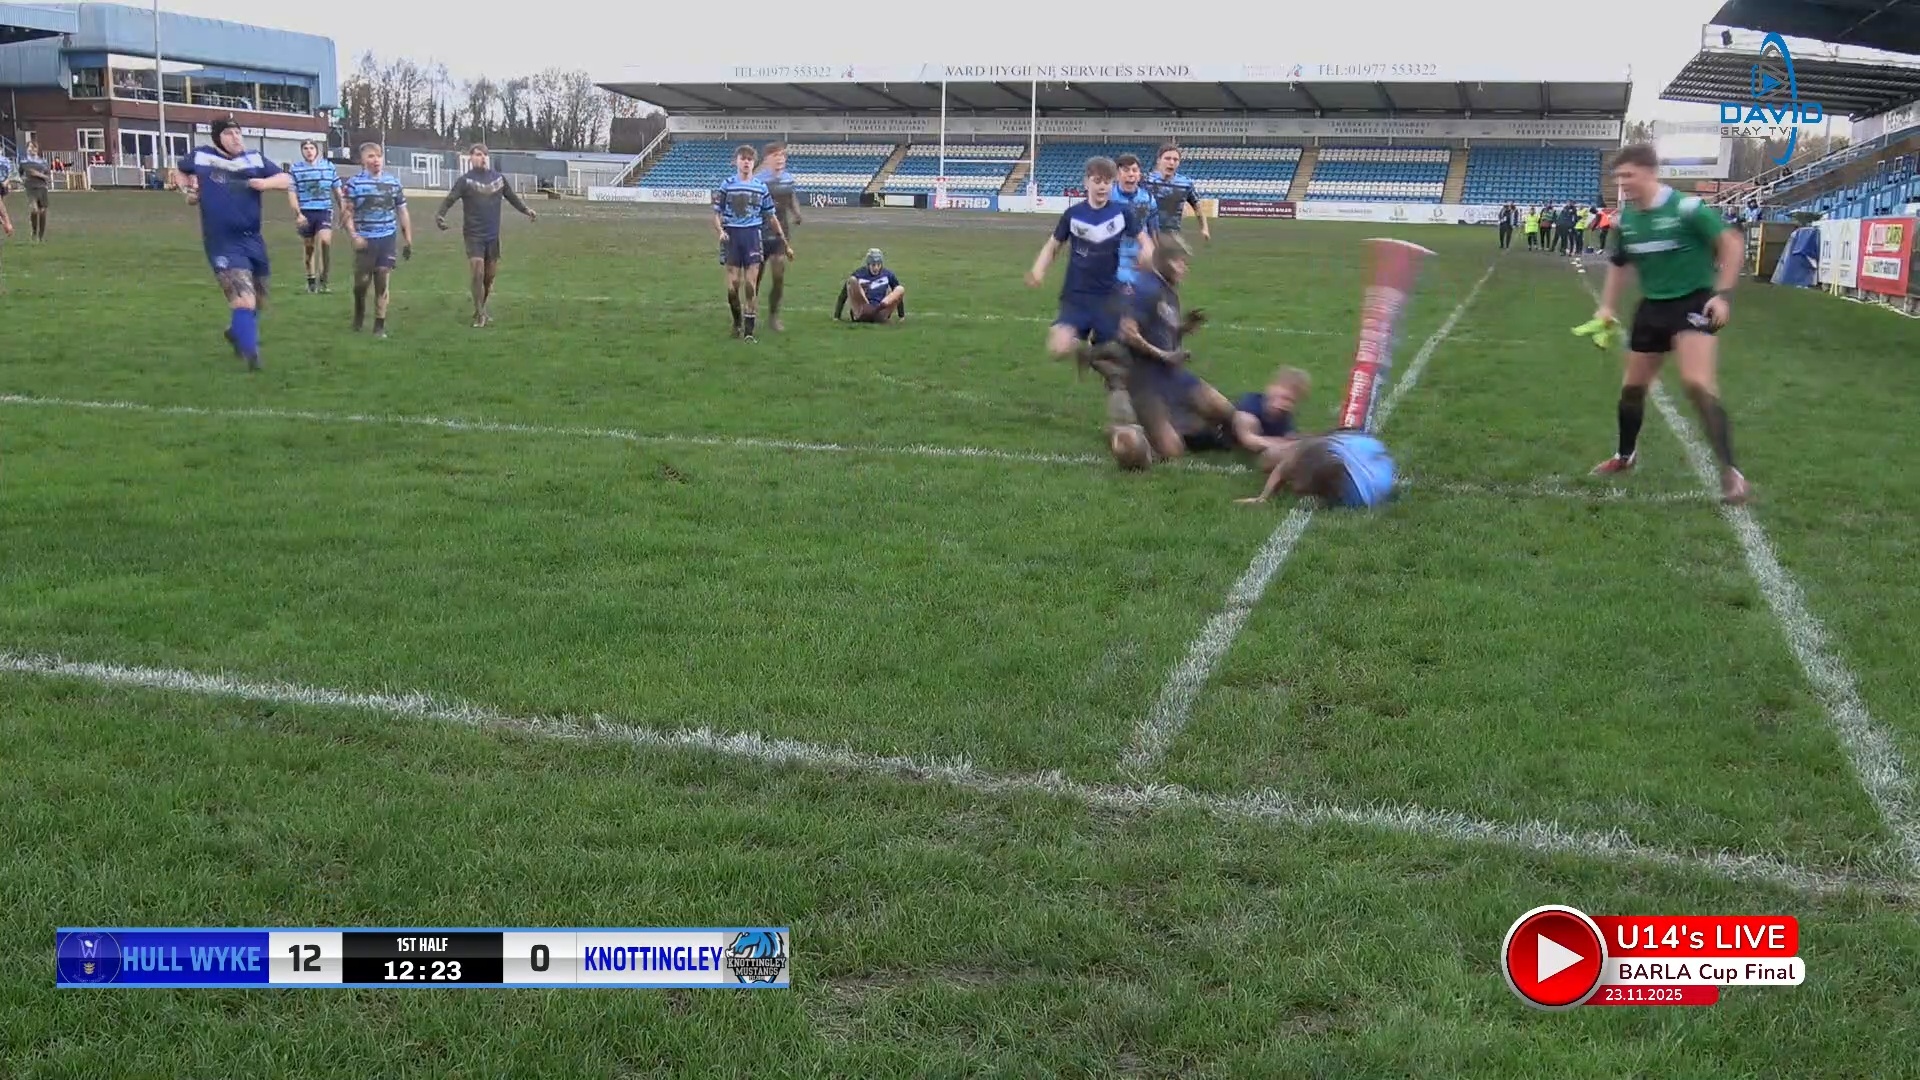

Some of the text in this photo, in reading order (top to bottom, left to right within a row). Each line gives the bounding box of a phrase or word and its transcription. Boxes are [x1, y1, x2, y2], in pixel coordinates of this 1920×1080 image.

[793, 65, 831, 78] 553322
[1060, 64, 1133, 77] SERVICES
[1136, 64, 1190, 77] STAND
[1317, 63, 1438, 76] TEL:01977 553322
[934, 197, 990, 209] ETFRED
